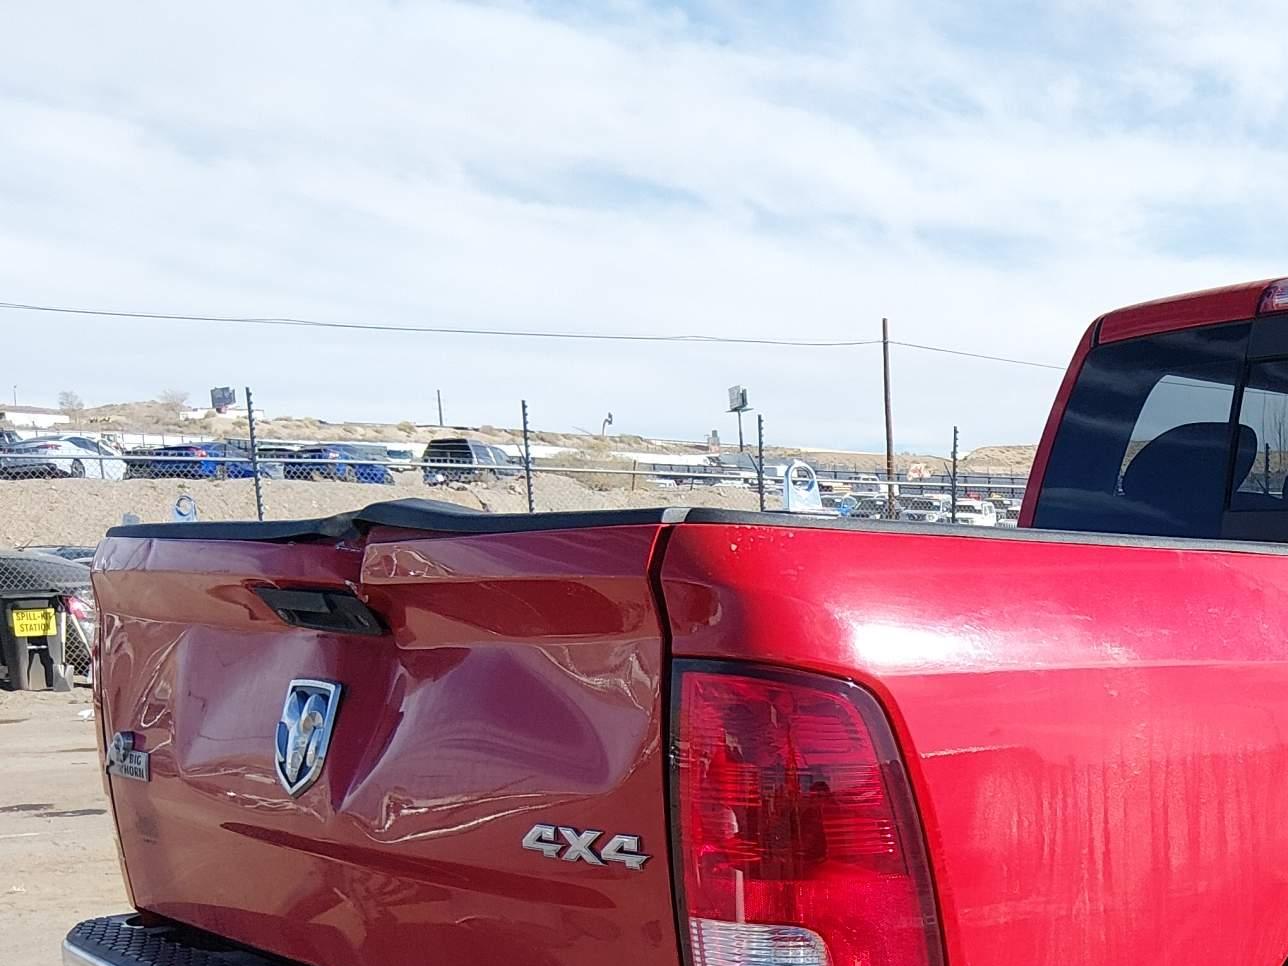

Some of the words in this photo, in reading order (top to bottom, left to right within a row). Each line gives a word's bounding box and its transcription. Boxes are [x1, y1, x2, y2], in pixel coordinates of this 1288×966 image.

[16, 611, 52, 621] SPILL-KIT
[20, 623, 50, 632] STATION
[129, 753, 142, 766] BIG
[123, 764, 145, 778] HORN
